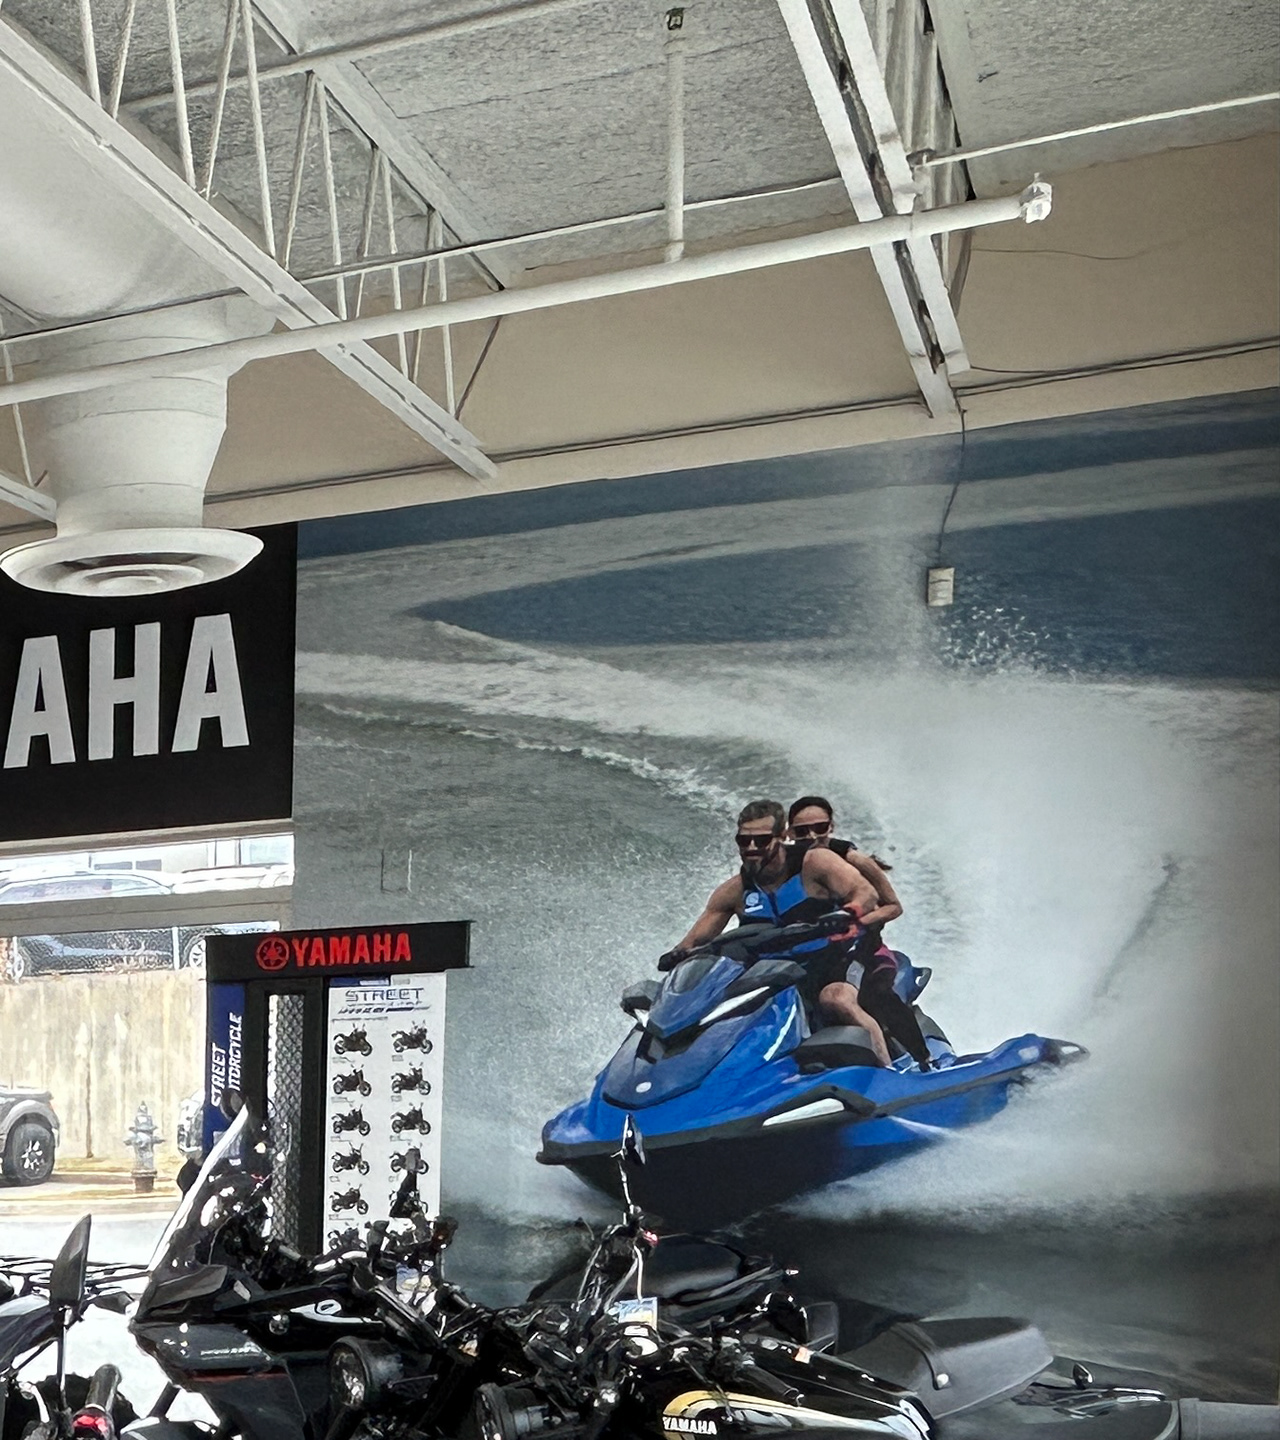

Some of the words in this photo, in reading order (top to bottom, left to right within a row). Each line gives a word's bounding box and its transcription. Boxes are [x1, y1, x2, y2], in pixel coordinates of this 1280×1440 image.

[292, 932, 411, 967] YAMAHA
[346, 987, 424, 1003] STREET
[211, 1042, 226, 1107] STREET
[662, 1416, 718, 1435] YAMAHA
